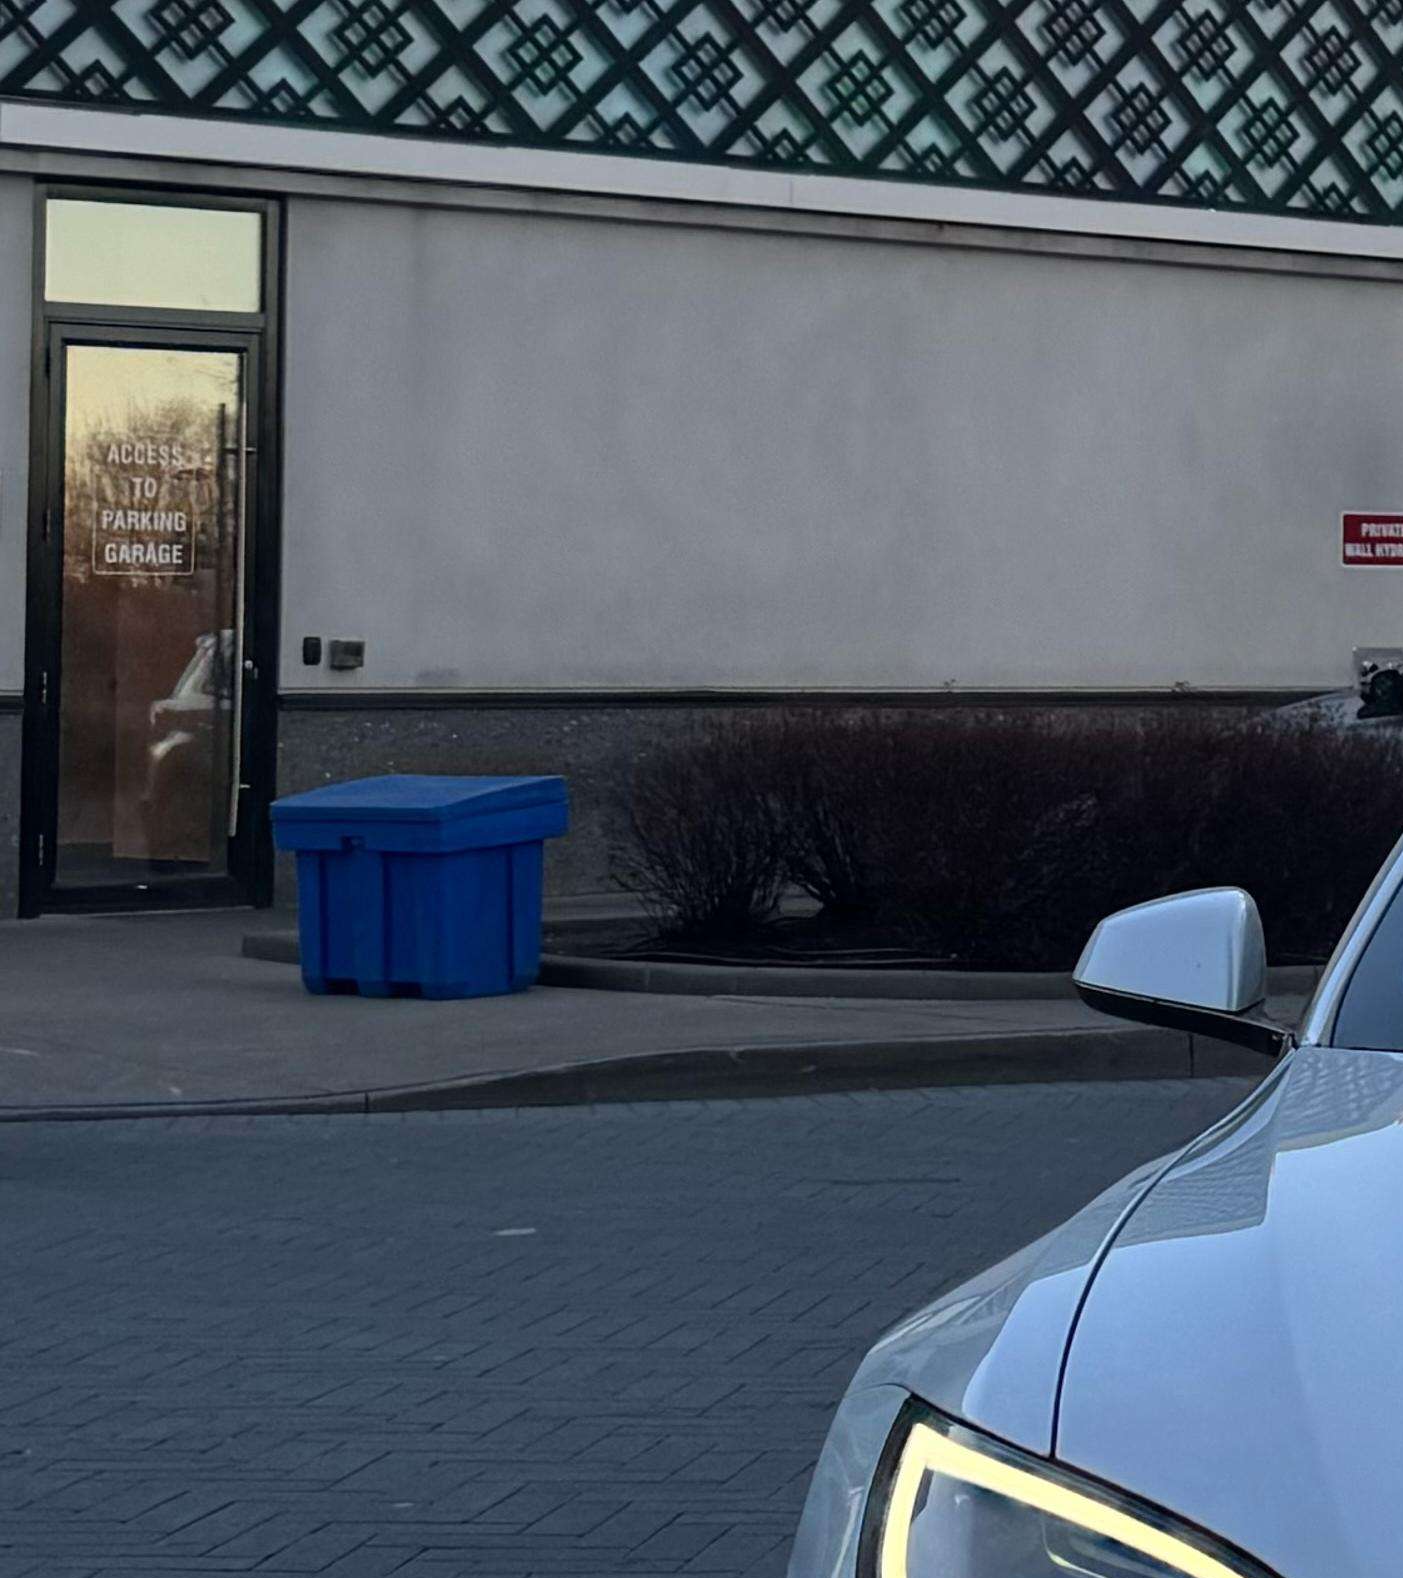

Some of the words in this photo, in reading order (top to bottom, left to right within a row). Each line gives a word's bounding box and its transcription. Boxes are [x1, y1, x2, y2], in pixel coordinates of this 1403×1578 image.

[106, 443, 184, 467] ACCESS
[130, 477, 158, 498] TO
[101, 509, 187, 532] PARKING
[104, 543, 183, 565] GARAGE
[1344, 543, 1374, 557] WALL
